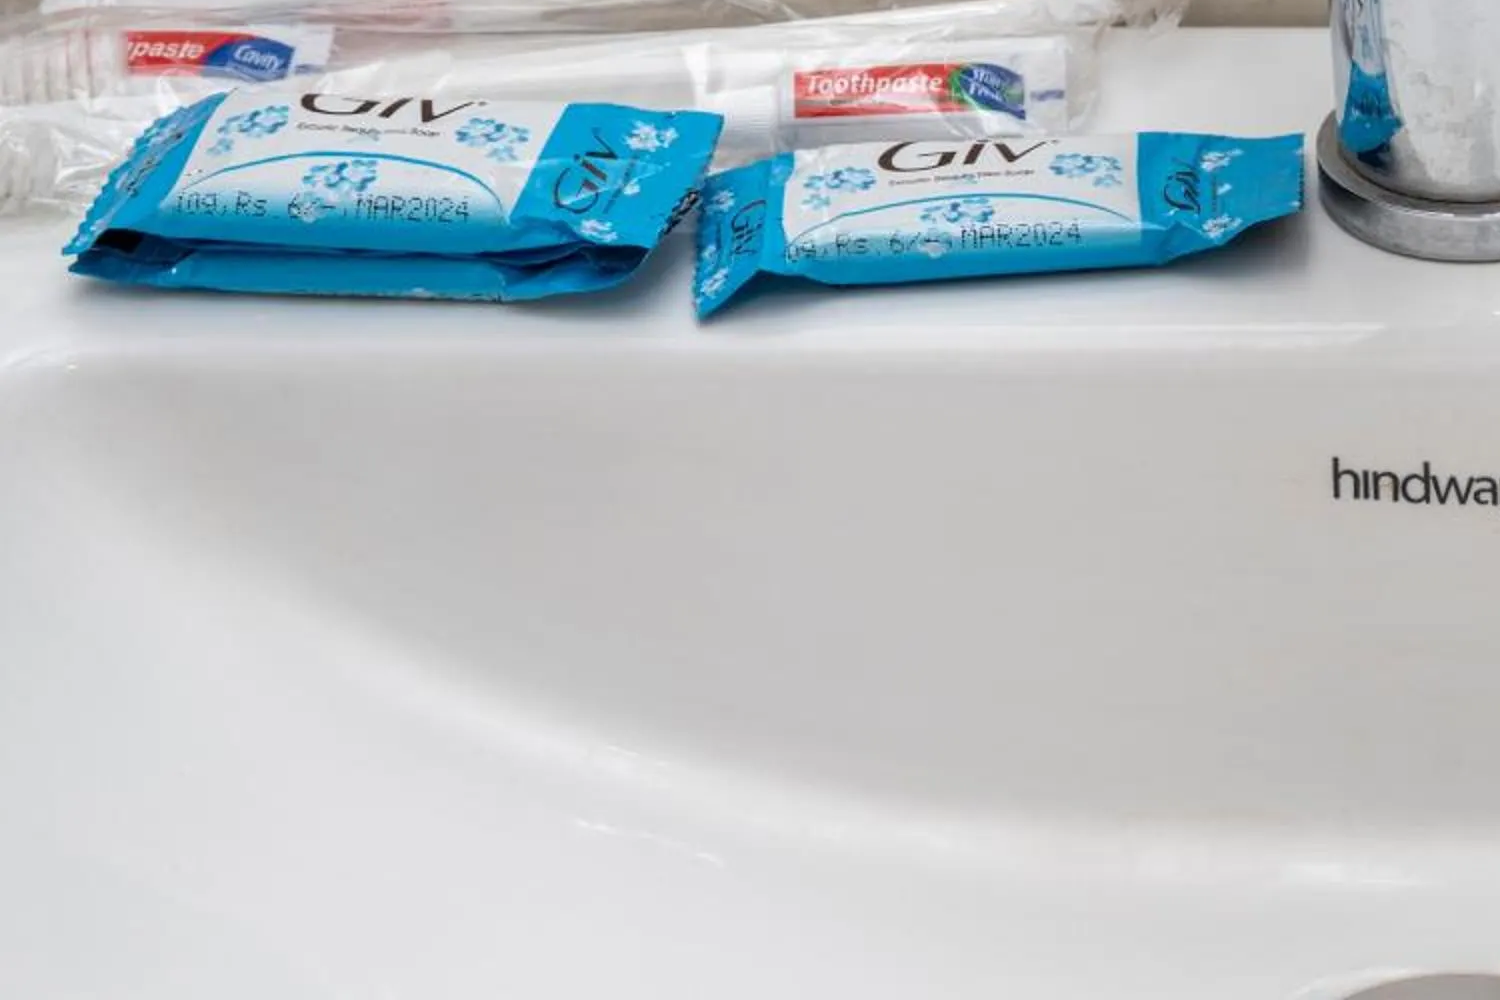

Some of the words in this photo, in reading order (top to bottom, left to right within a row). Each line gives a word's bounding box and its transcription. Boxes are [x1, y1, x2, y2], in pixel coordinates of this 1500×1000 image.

[128, 39, 206, 60] paste
[233, 45, 285, 70] Cavity
[805, 72, 943, 96] Toothpaste
[961, 216, 1083, 249] MAR2024
